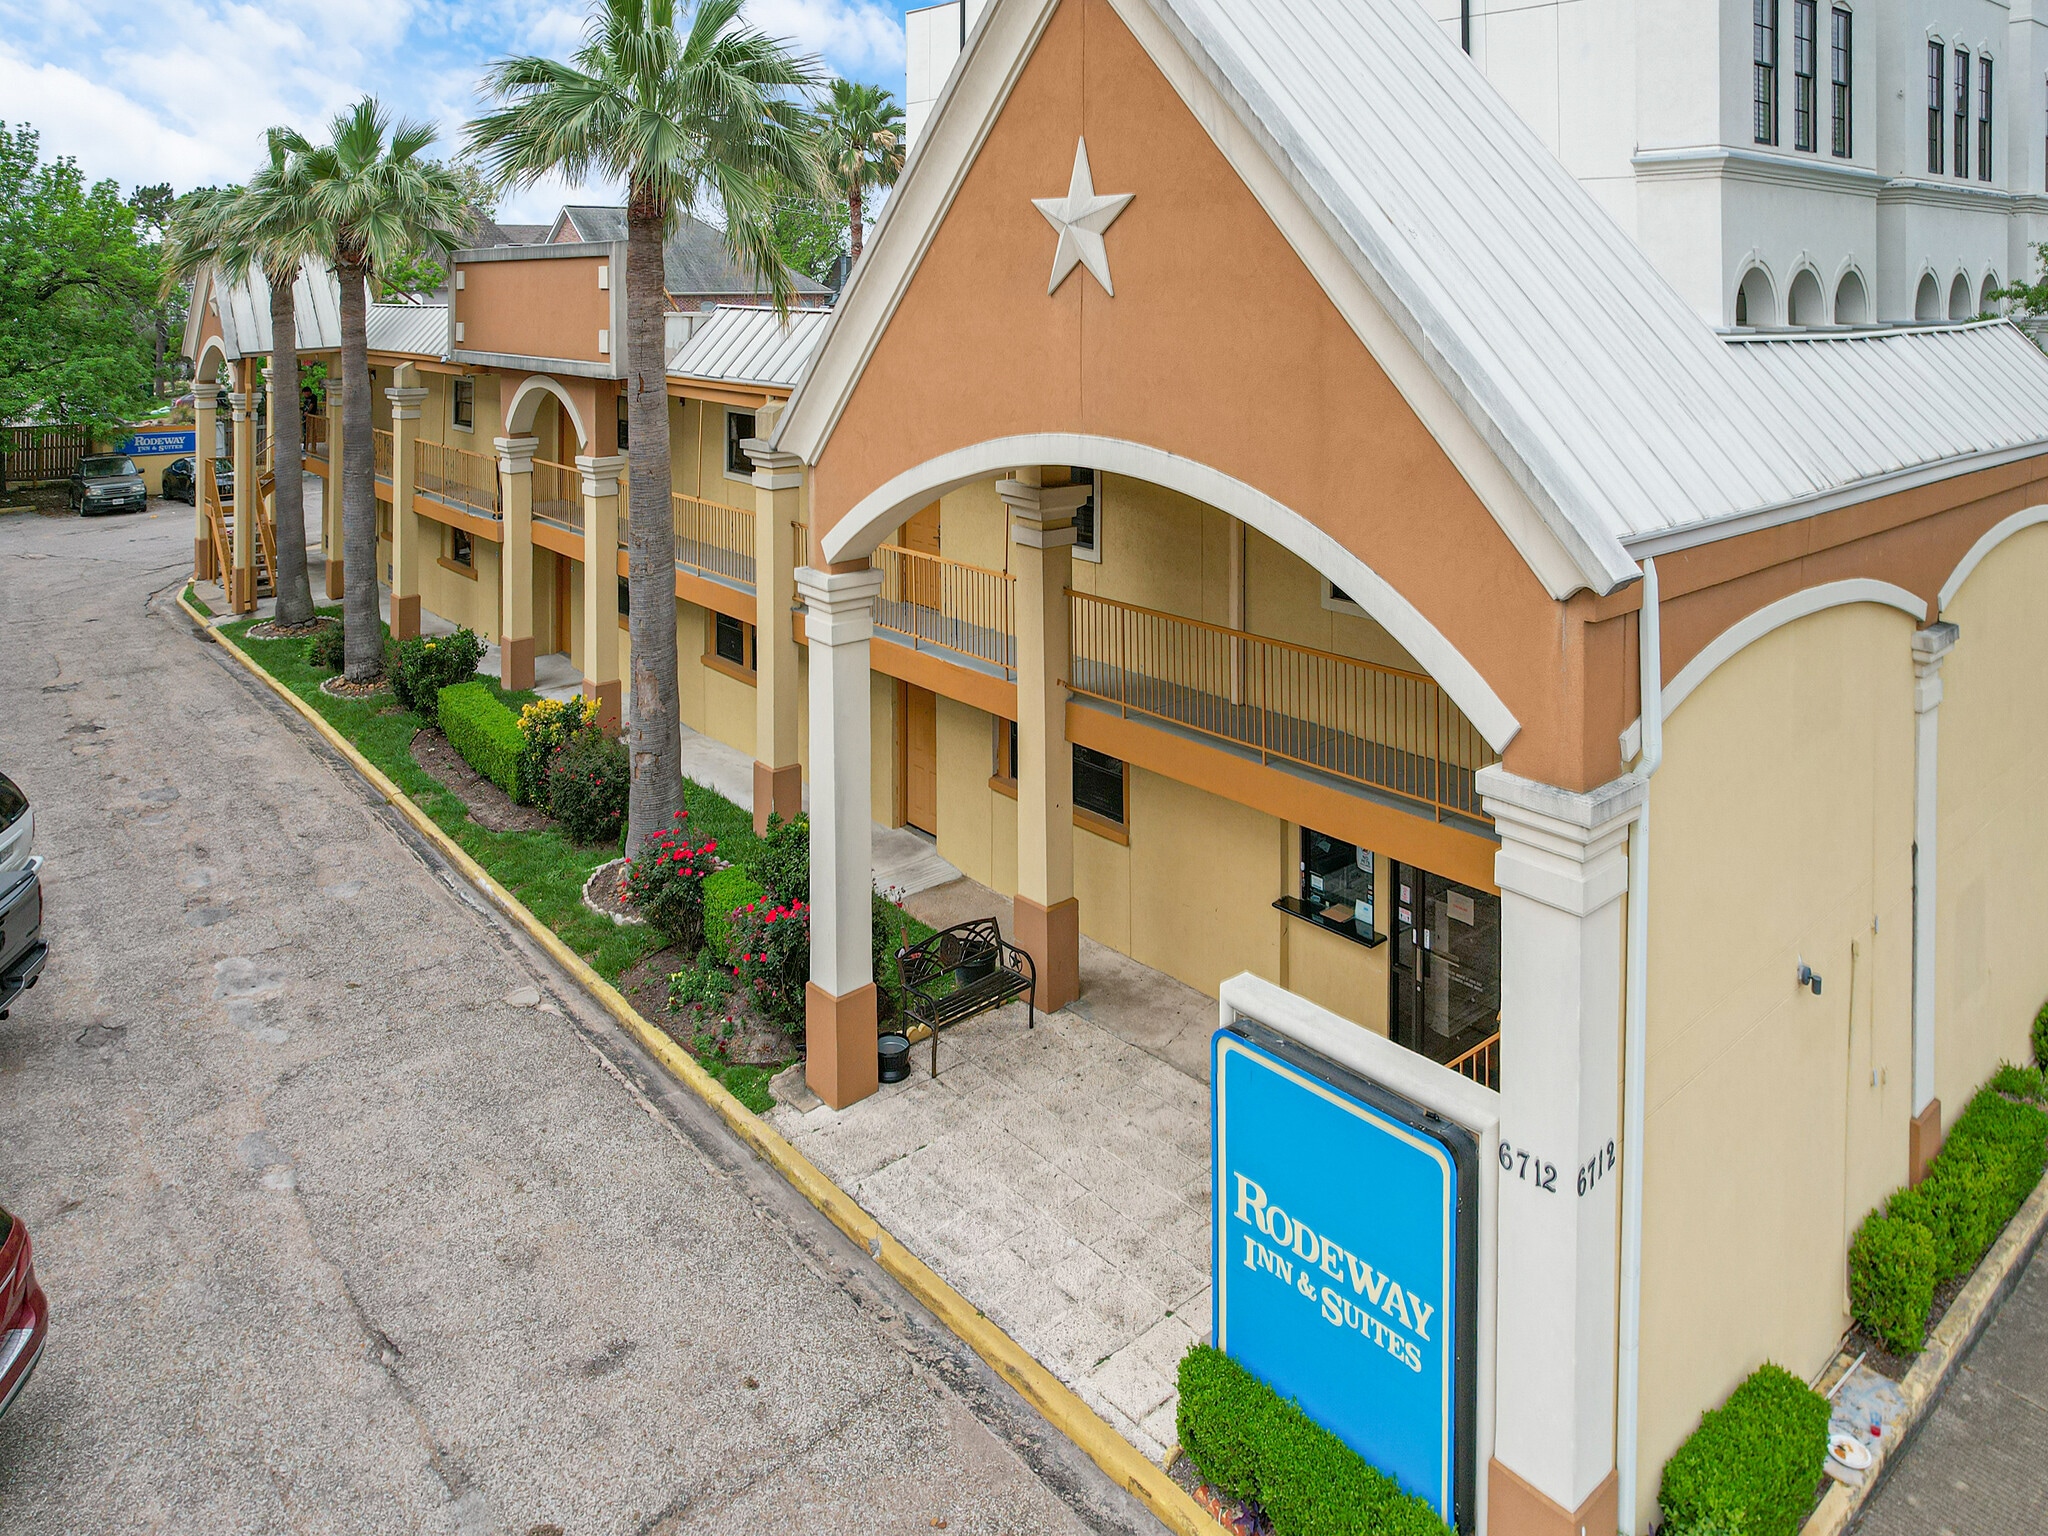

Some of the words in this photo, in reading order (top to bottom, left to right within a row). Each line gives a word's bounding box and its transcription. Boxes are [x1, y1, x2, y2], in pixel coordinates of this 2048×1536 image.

[134, 436, 186, 446] RODEWAY
[158, 444, 183, 452] SUITES
[1498, 1141, 1557, 1194] 6712
[1577, 1139, 1616, 1197] 6712
[1233, 1170, 1435, 1342] RODEWAY
[1243, 1234, 1294, 1286] INN
[1297, 1271, 1318, 1303] &
[1321, 1286, 1423, 1374] SUITES
